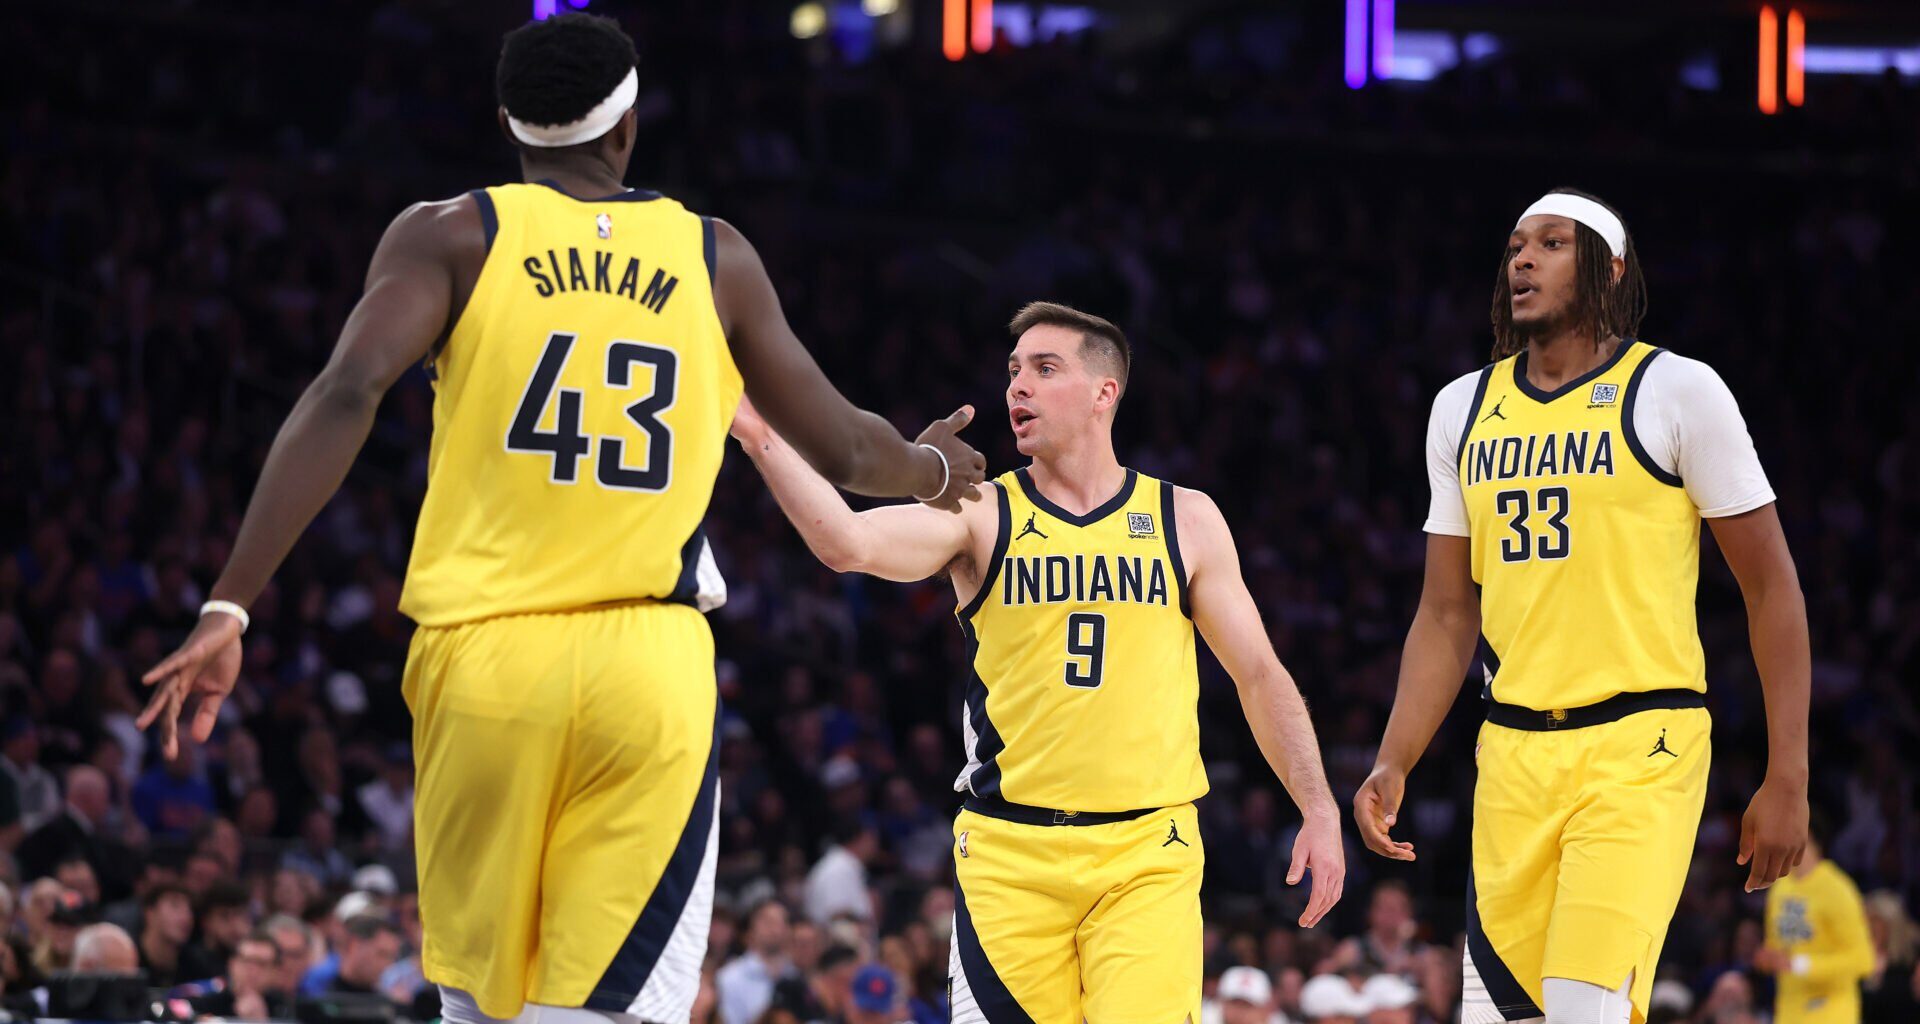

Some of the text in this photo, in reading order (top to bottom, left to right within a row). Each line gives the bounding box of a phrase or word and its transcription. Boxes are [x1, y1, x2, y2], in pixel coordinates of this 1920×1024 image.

[523, 248, 679, 314] SIAKAM
[505, 331, 679, 493] 43
[1467, 431, 1615, 486] INDIANA
[1496, 487, 1570, 562] 33
[1003, 555, 1168, 606] INDIANA
[1064, 612, 1106, 688] 9
